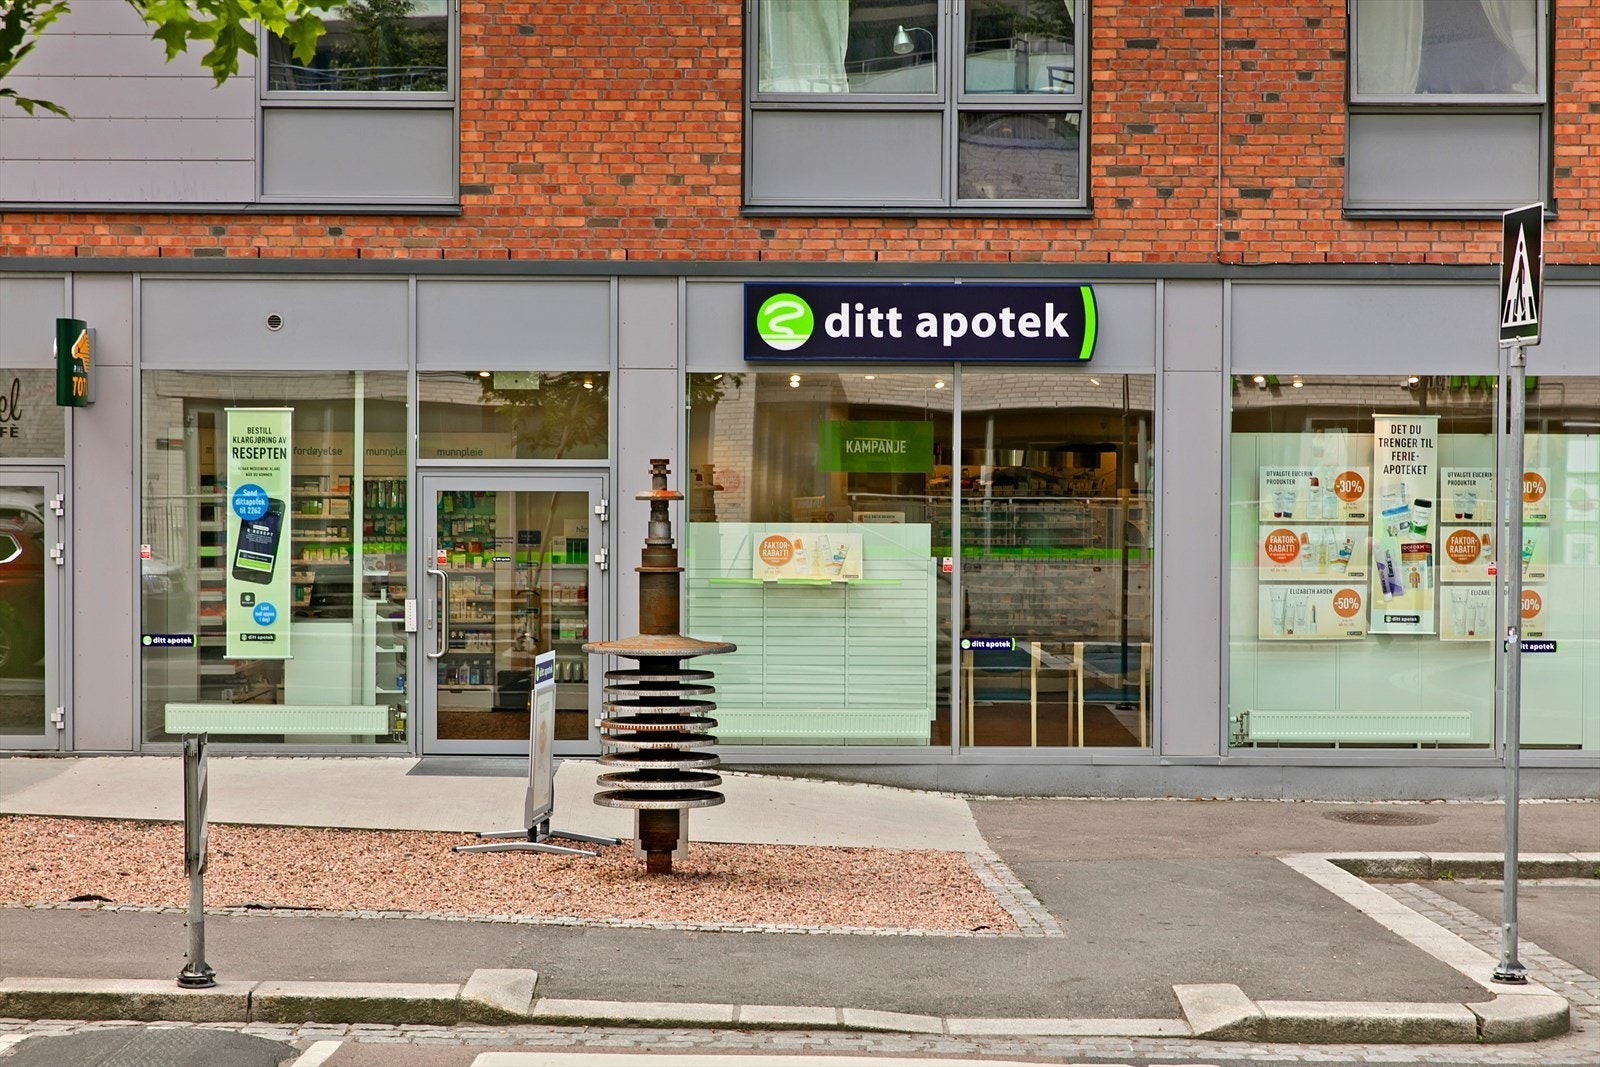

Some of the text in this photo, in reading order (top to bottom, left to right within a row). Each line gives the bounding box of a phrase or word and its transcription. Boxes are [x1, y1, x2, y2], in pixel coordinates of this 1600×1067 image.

[825, 303, 1069, 347] ditt apotek
[247, 426, 272, 434] BESTILL
[1391, 425, 1422, 434] DET DU
[232, 436, 276, 444] KLARGJØRING
[1378, 438, 1434, 448] TRENGER TIL
[293, 446, 342, 457] fordøyelse
[846, 440, 906, 454] KAMPANJE
[232, 447, 287, 459] RESEPTEN
[366, 447, 407, 458] munnplei
[436, 448, 483, 458] munnpleie
[1392, 451, 1419, 461] FERIE-
[1383, 465, 1427, 475] APOTEKET
[1336, 480, 1362, 493] -30%
[243, 489, 258, 497] Send
[236, 498, 265, 506] dittapotek
[1270, 536, 1296, 544] FAKTOR-
[1451, 537, 1478, 545] FAKTOR-
[1269, 544, 1295, 552] RABATT!
[1450, 545, 1476, 553] RABATT!
[763, 549, 788, 557] RABATT!
[1334, 597, 1358, 610] -50%
[167, 637, 192, 645] apotek
[1530, 643, 1554, 651] apotek
